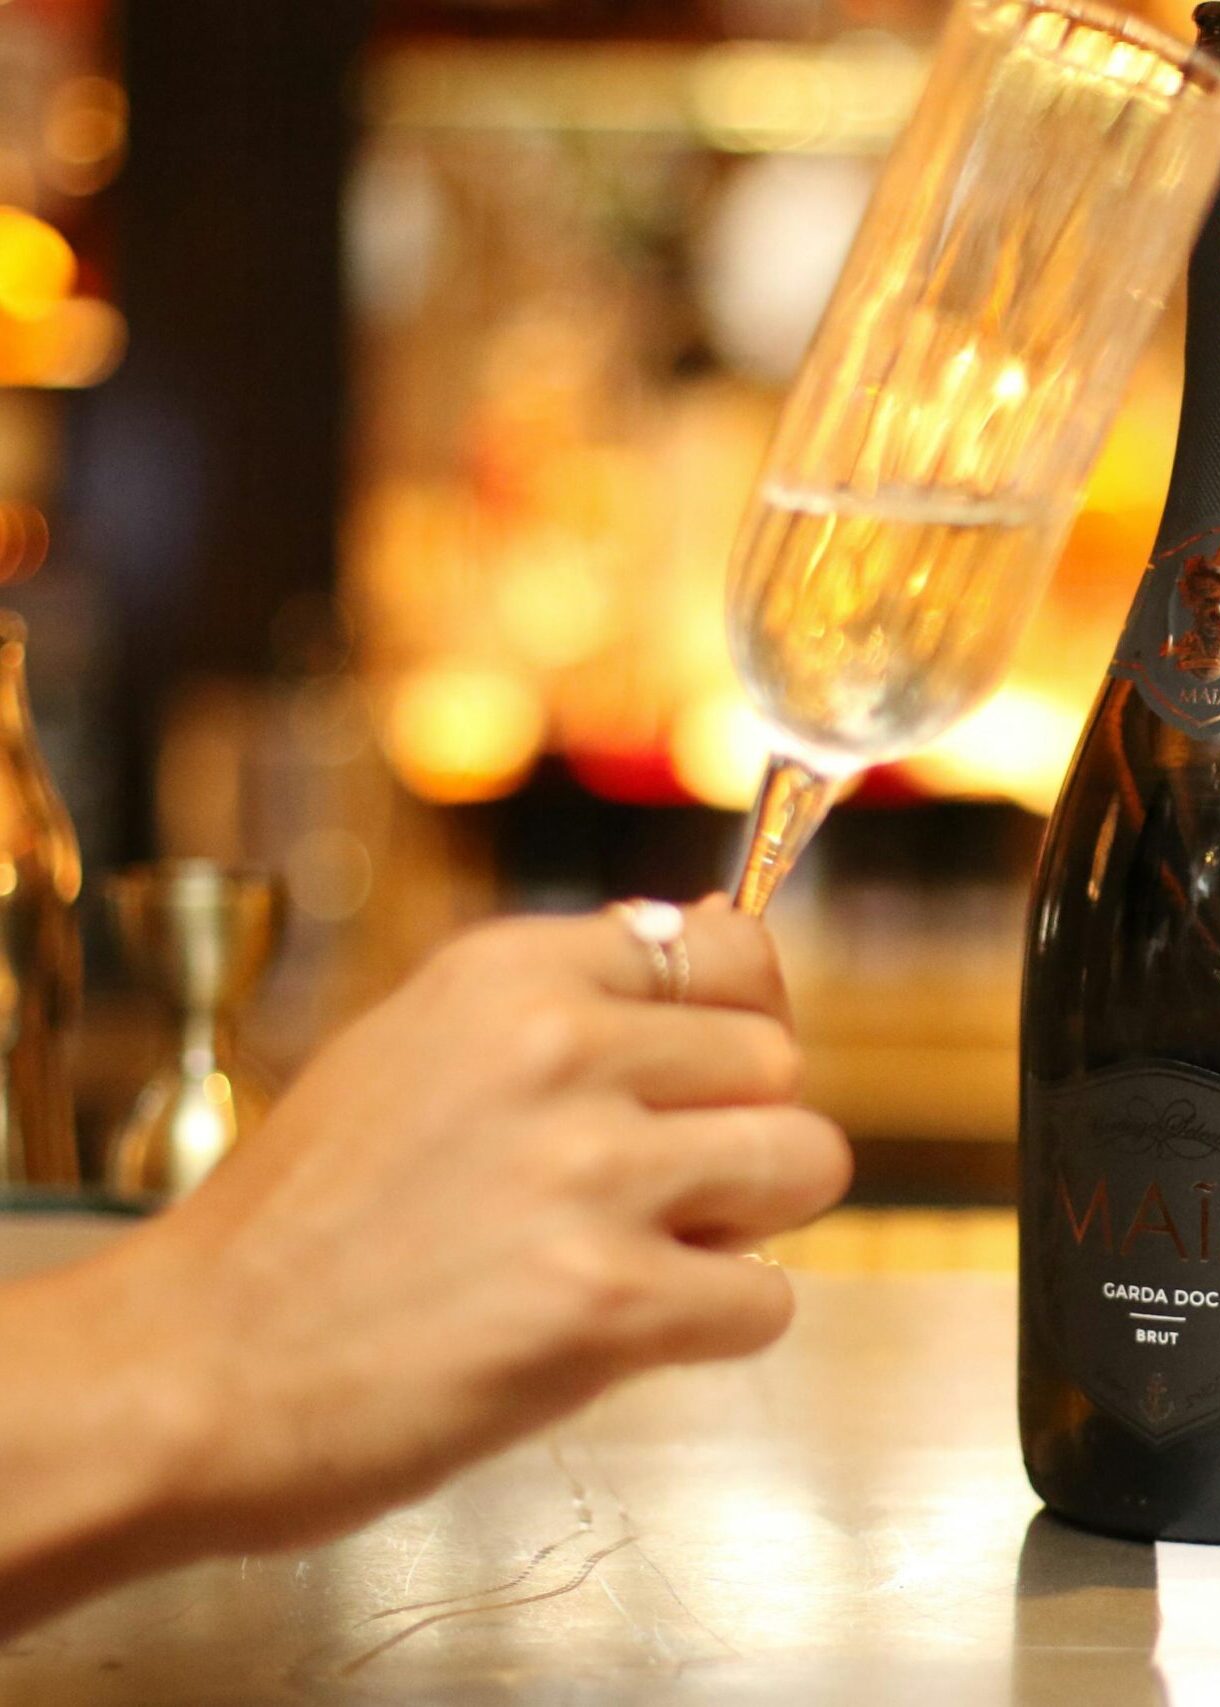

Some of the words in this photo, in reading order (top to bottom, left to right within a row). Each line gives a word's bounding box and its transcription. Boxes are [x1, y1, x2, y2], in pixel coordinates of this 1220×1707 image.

[1103, 1282, 1168, 1304] GARDA
[1174, 1289, 1219, 1308] DOC
[1136, 1328, 1179, 1345] BRUT
